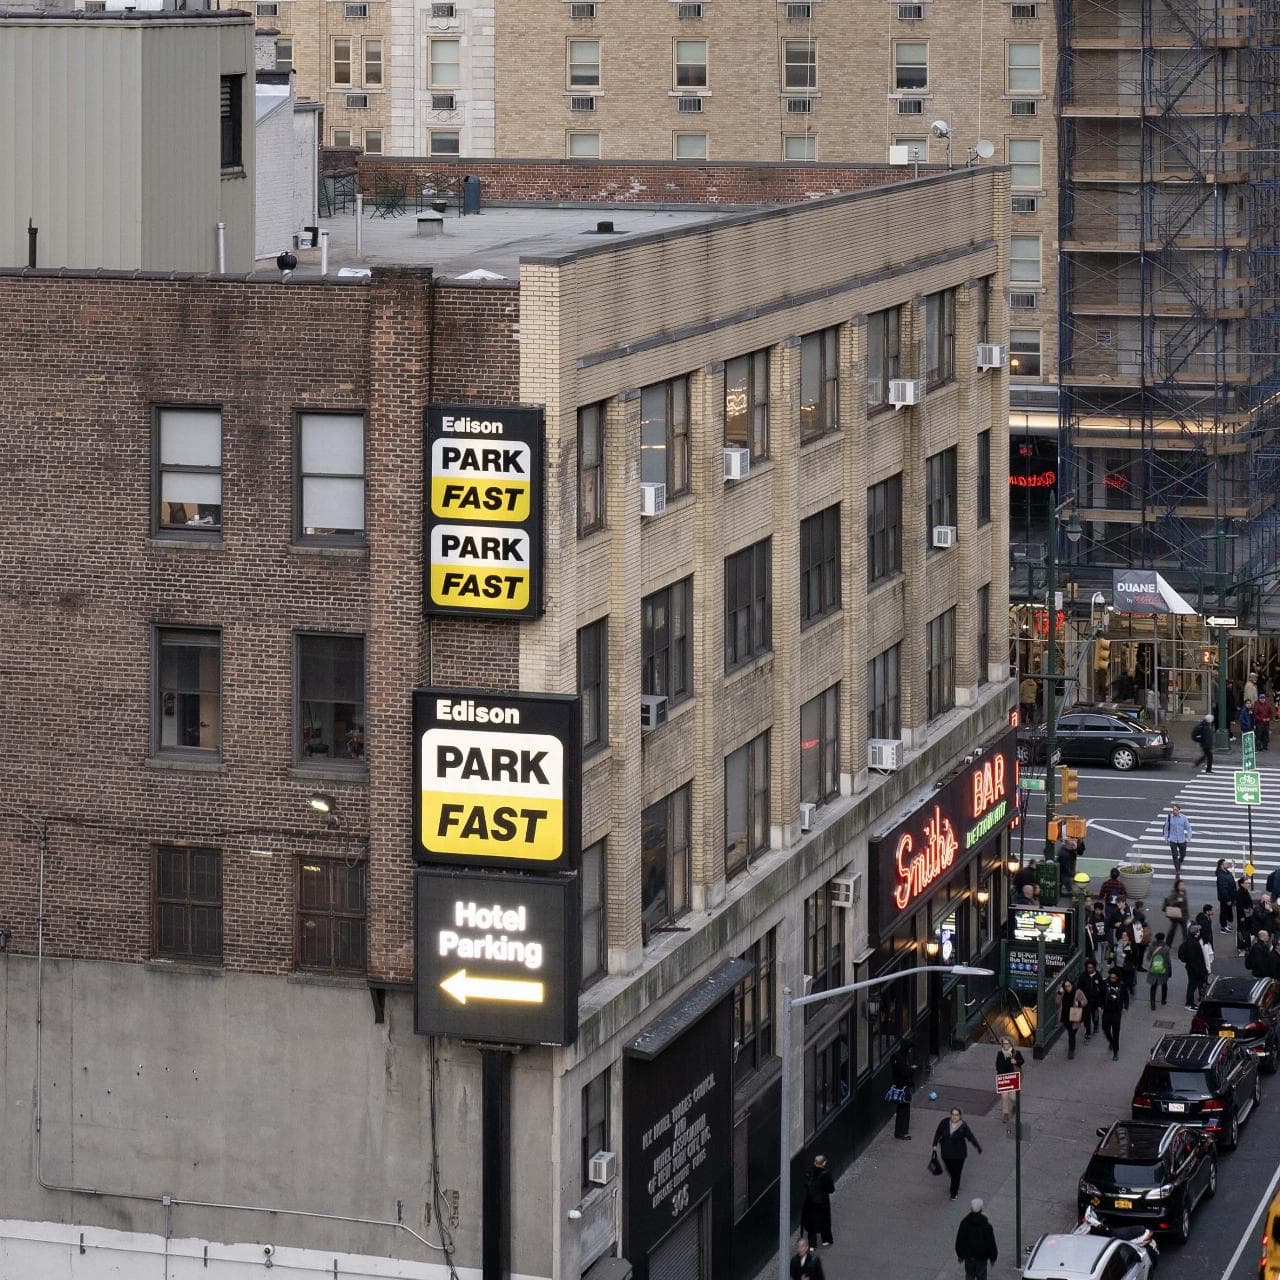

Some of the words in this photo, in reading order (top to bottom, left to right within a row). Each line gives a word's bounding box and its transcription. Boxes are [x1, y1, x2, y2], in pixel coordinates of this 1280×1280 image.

[442, 416, 503, 434] Edison
[441, 446, 524, 473] PARK
[441, 484, 524, 511] FAST
[441, 534, 524, 561] PARK
[441, 572, 524, 599] FAST
[1117, 582, 1156, 593] DUANE
[436, 699, 520, 725] Edison
[437, 745, 550, 785] PARK
[973, 753, 1005, 818] BAR
[437, 803, 548, 844] FAST
[896, 805, 959, 909] Smith's
[454, 900, 527, 932] Hotel
[438, 930, 543, 969] Parking
[672, 1093, 692, 1123] TRADES
[693, 1073, 716, 1103] COUNCIL
[671, 1184, 690, 1217] 305
